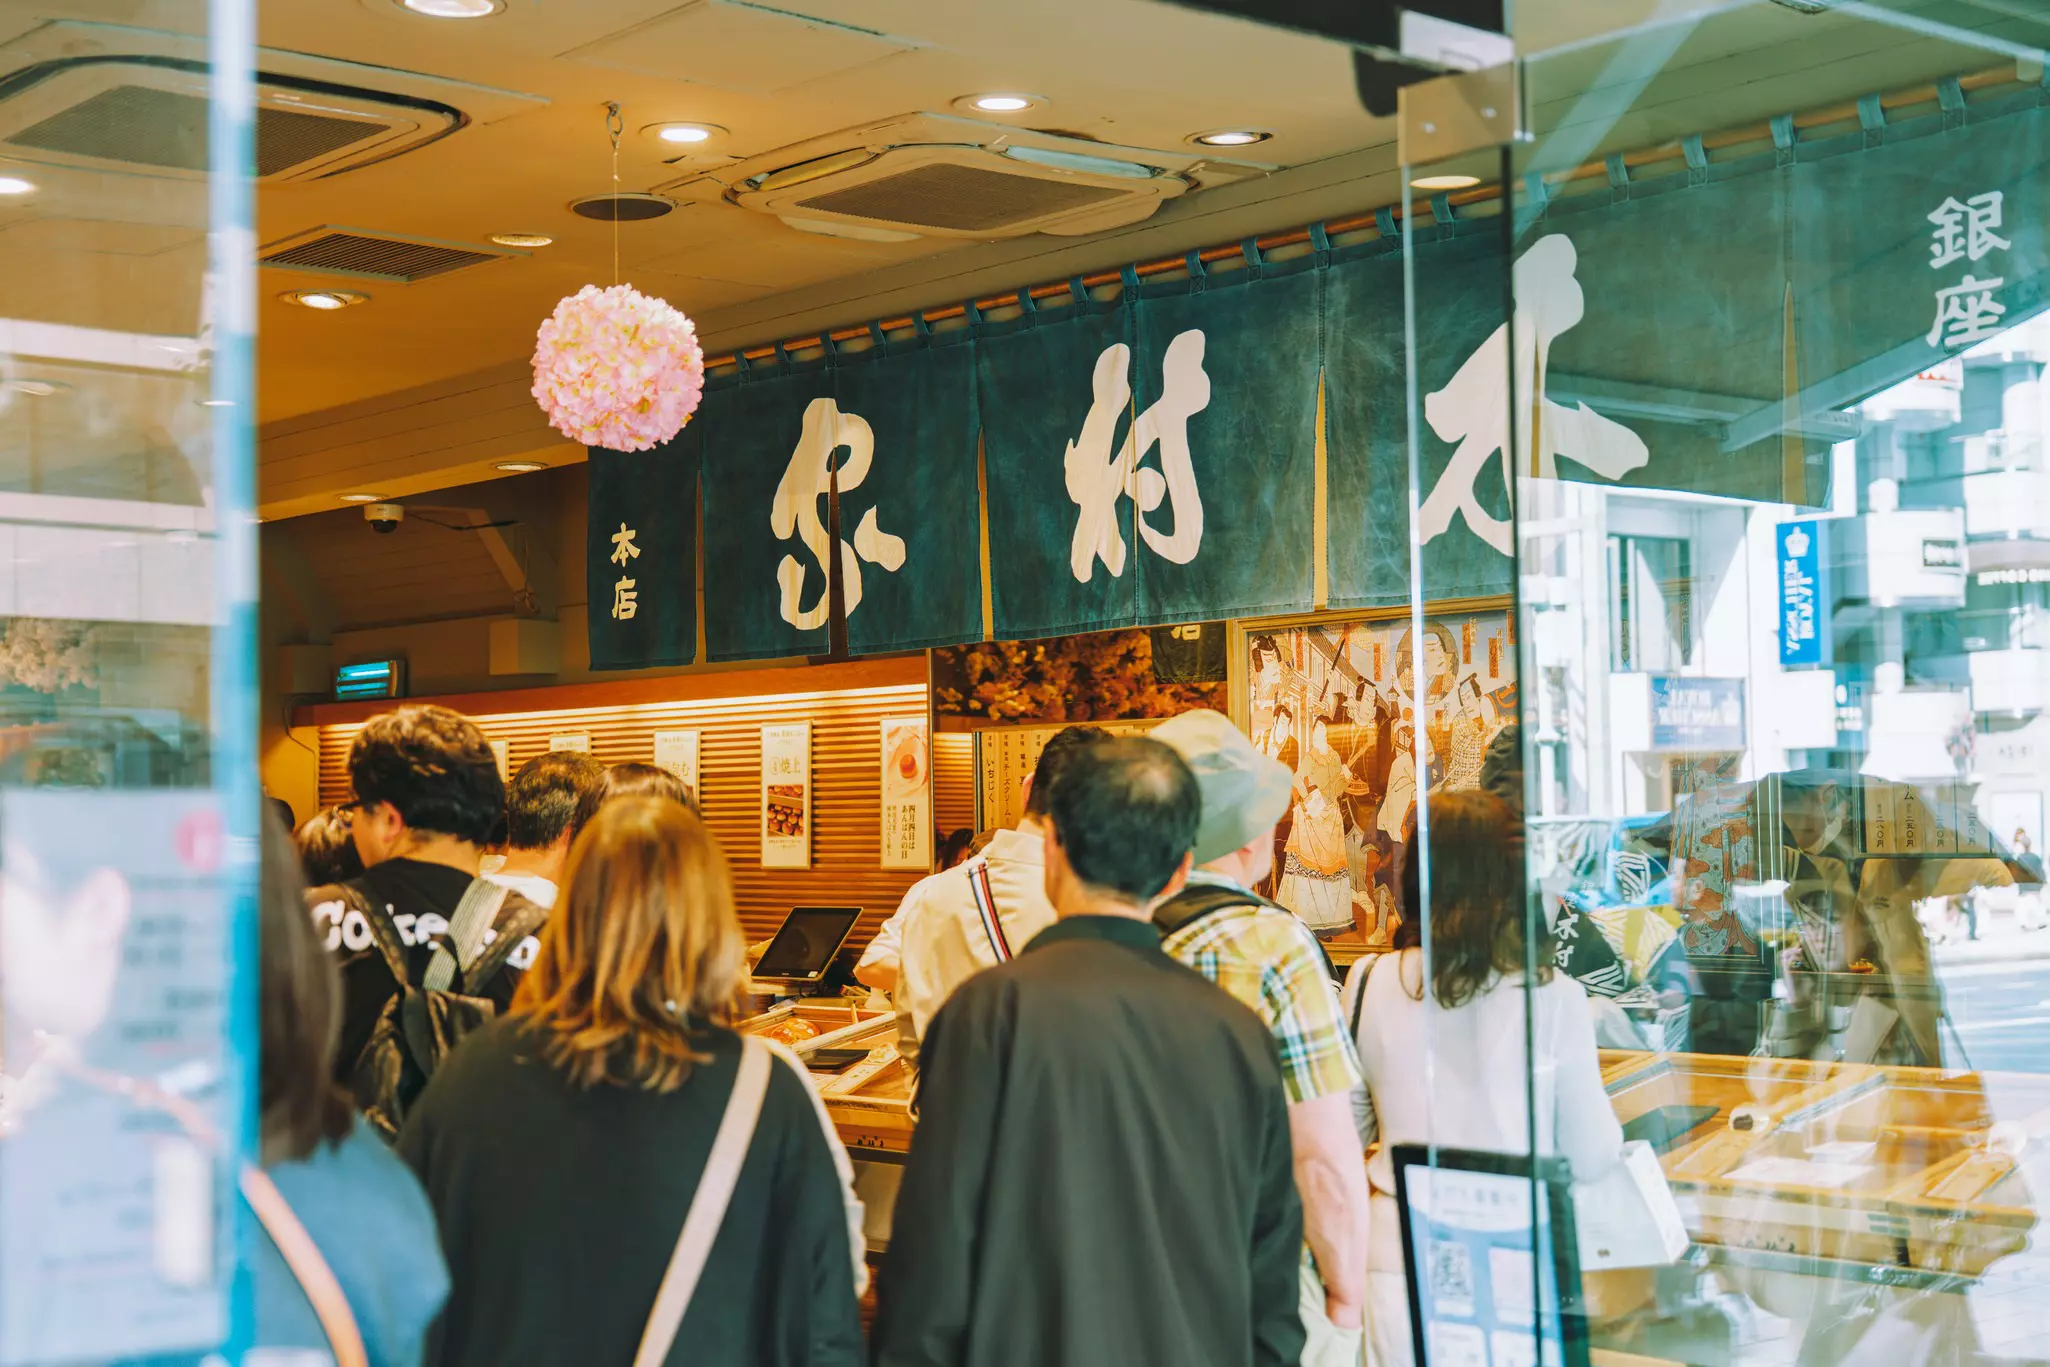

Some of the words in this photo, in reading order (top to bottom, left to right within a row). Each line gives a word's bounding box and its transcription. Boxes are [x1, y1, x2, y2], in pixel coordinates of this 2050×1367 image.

[1925, 189, 2011, 350] 銀座
[610, 521, 641, 622] 本店
[986, 757, 995, 803] いちじく
[1904, 816, 1915, 848] 二五〇円
